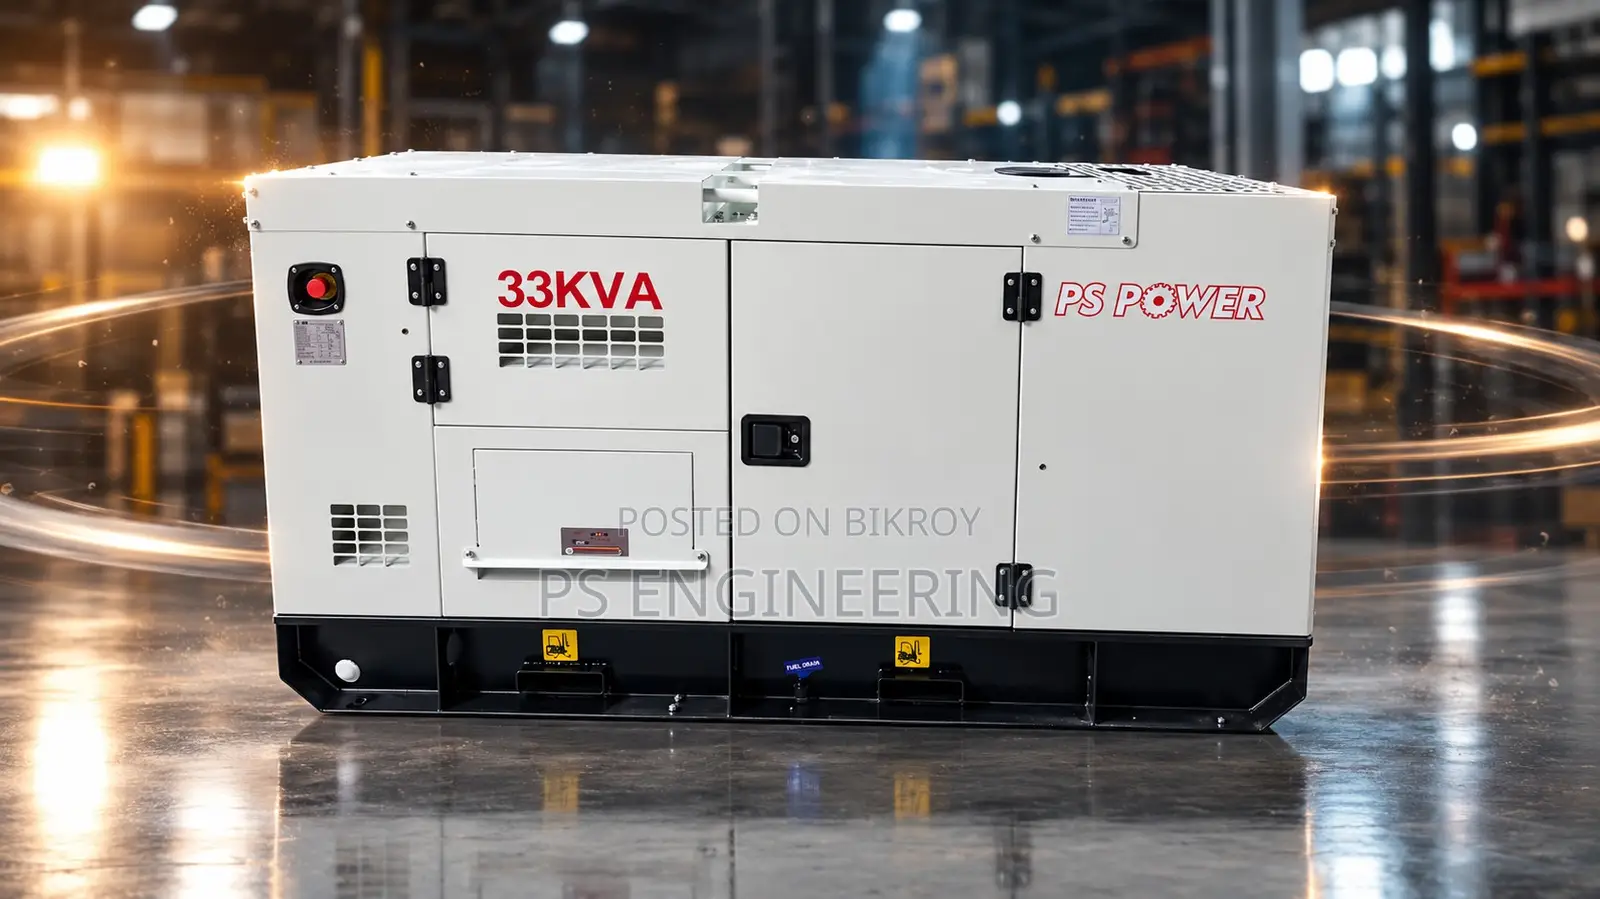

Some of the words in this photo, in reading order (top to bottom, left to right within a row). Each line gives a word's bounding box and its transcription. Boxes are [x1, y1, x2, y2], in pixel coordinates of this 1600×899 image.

[497, 269, 663, 310] 33KVA
[1054, 281, 1107, 317] PS
[1113, 282, 1266, 320] POWER
